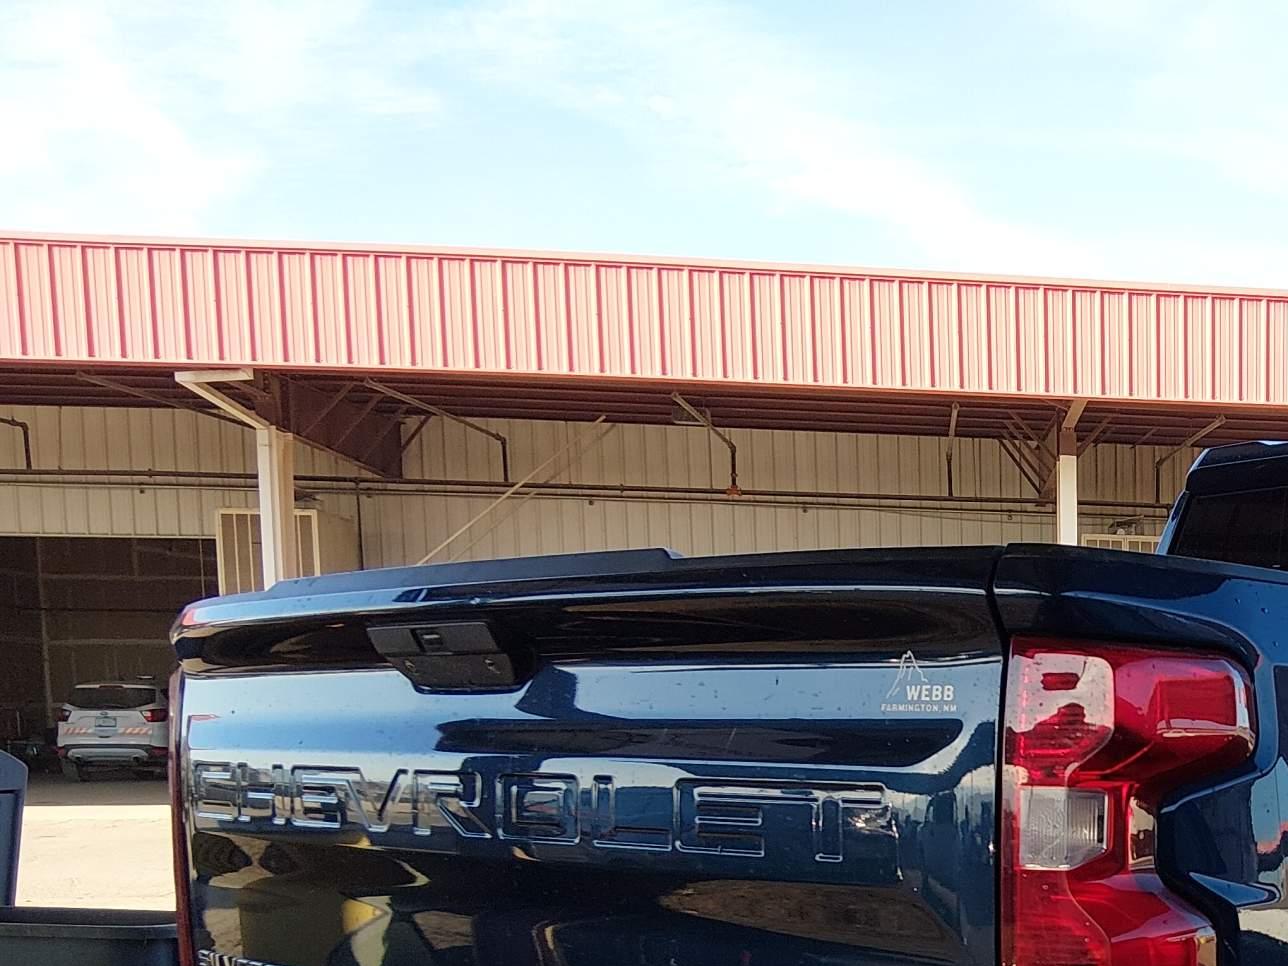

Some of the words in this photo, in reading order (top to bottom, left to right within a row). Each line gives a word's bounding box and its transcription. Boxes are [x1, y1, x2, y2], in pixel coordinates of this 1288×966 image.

[907, 685, 955, 701] WEBB
[943, 704, 957, 712] NM
[192, 762, 894, 864] CHEVROLET
